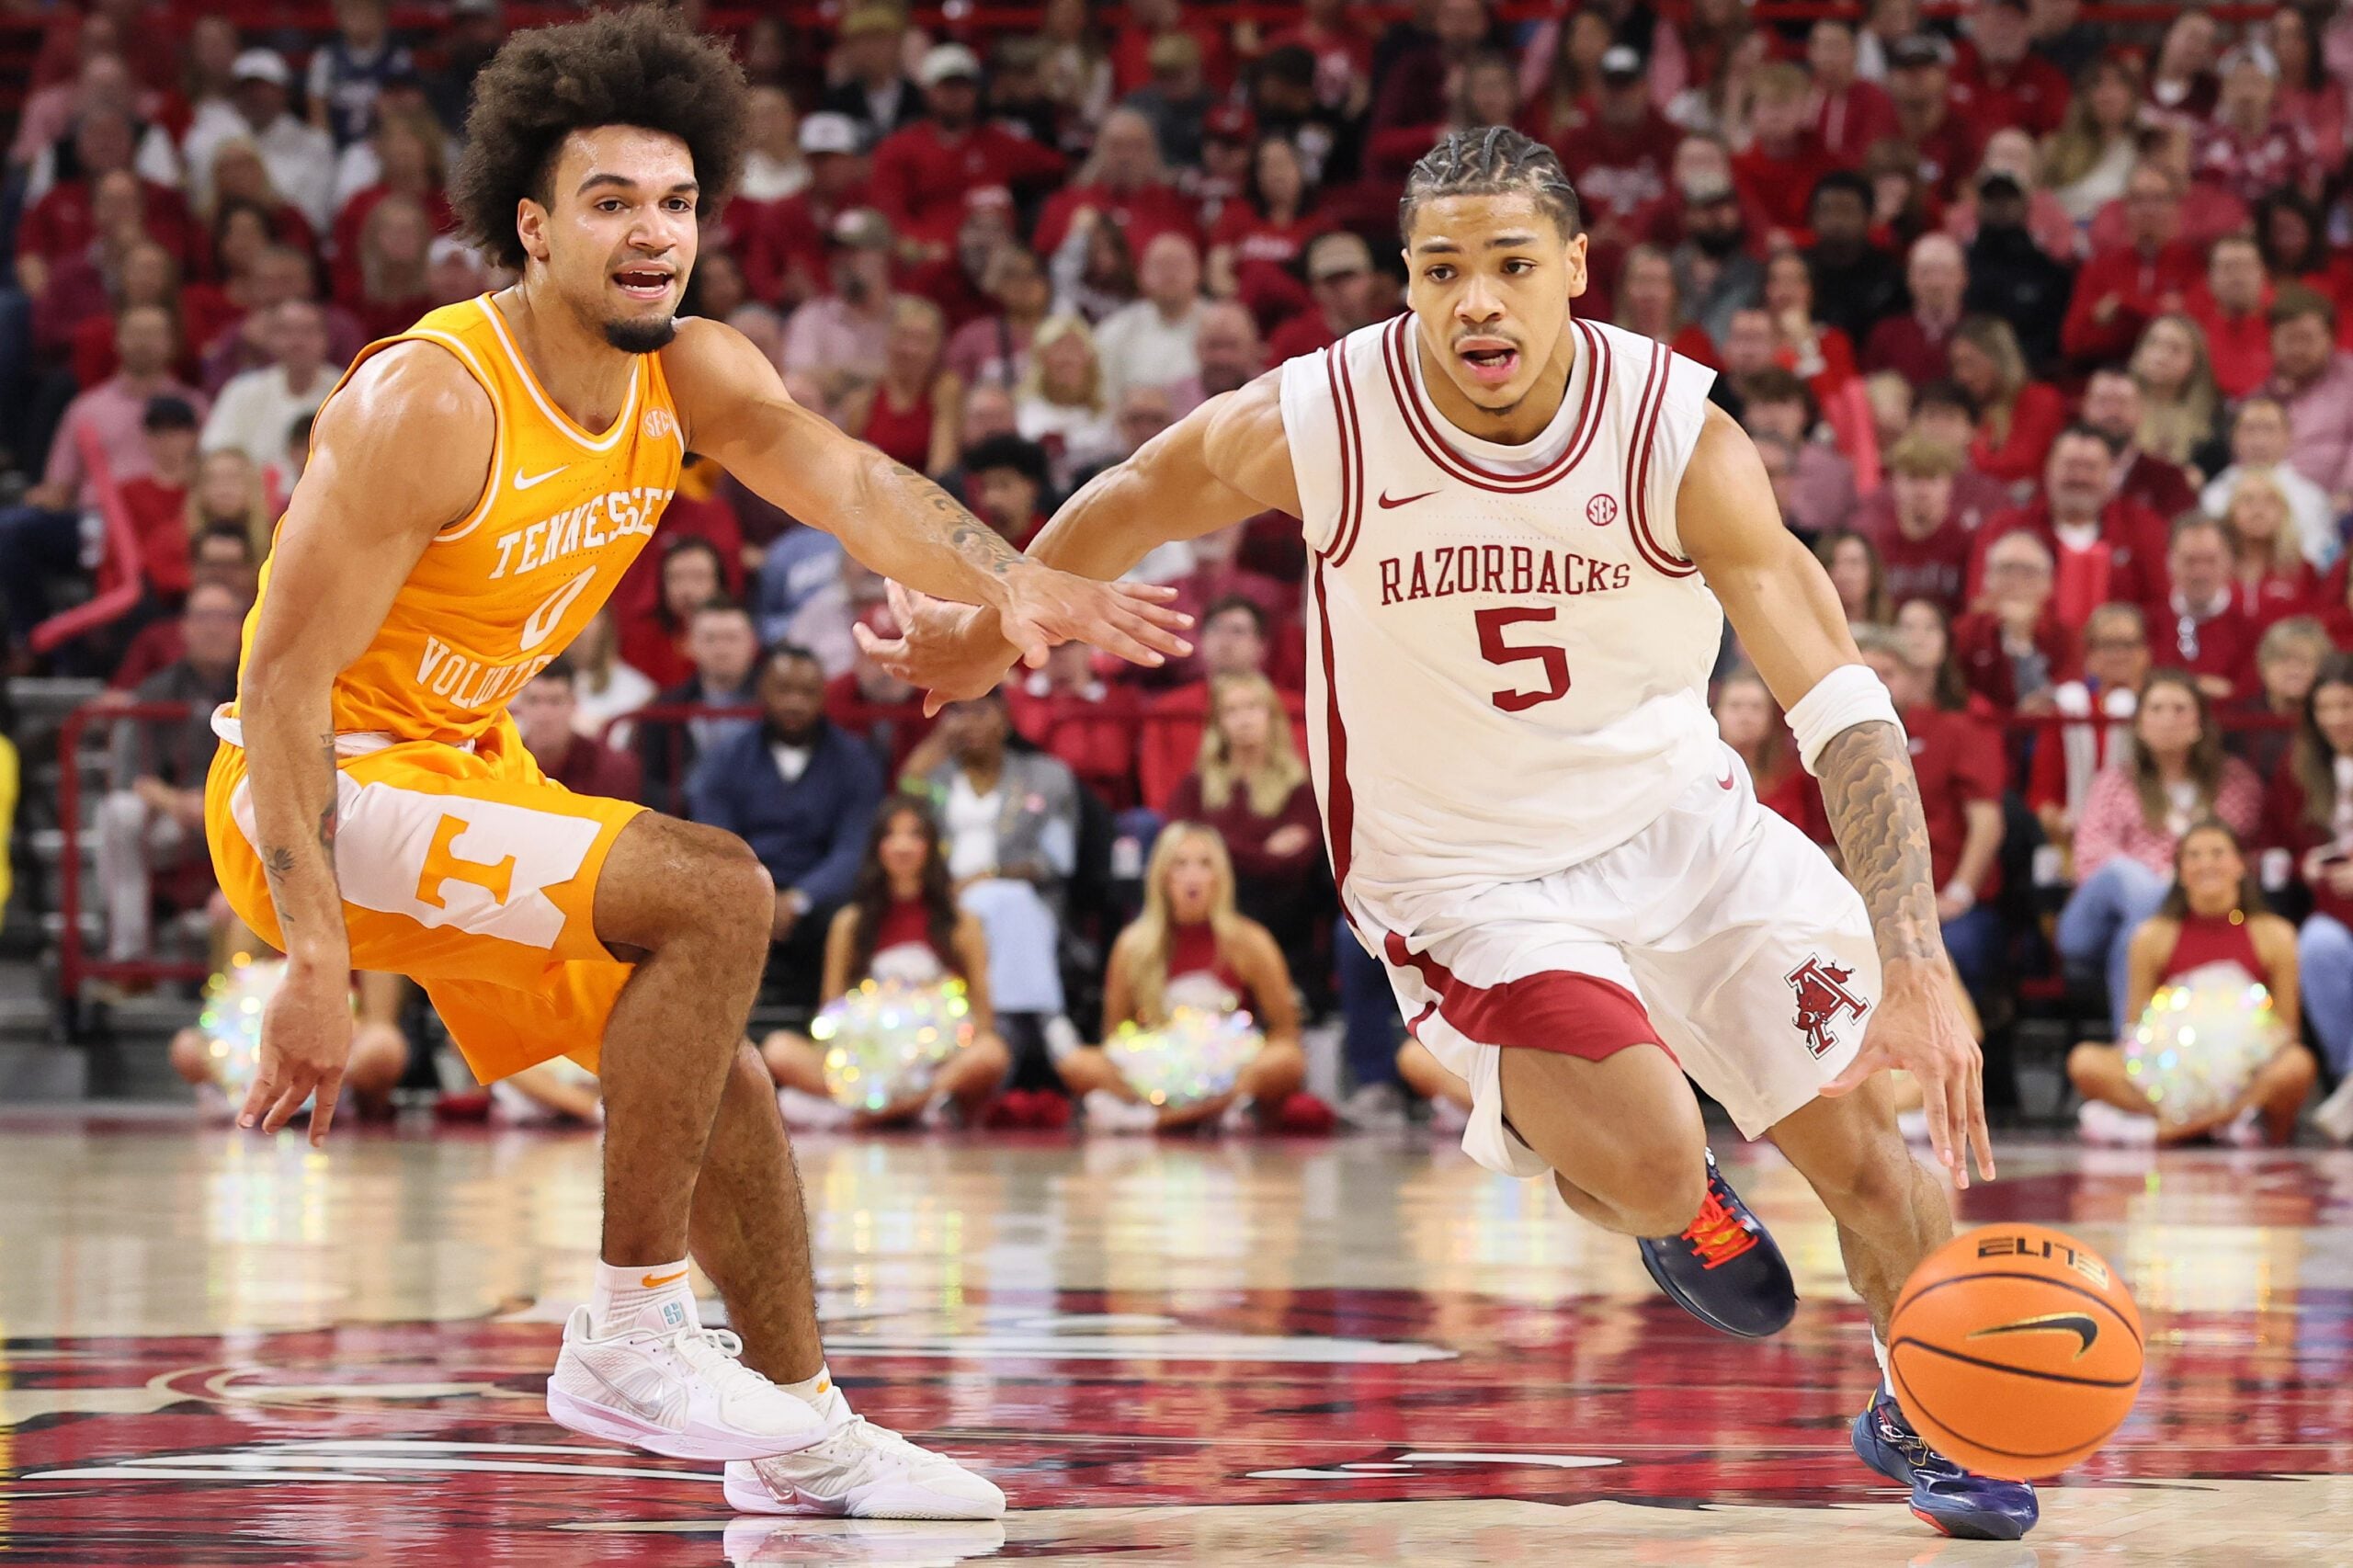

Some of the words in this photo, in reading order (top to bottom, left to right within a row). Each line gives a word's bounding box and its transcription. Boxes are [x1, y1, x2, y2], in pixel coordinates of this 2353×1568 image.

[642, 408, 672, 438] SEC
[488, 487, 675, 580] TENNESSE
[1587, 494, 1618, 526] SEC
[519, 564, 597, 652] 0
[1379, 544, 1631, 606] RAZORBACKS
[1474, 607, 1571, 712] 5
[415, 812, 517, 910] T
[1978, 1238, 2109, 1290] ELITE
